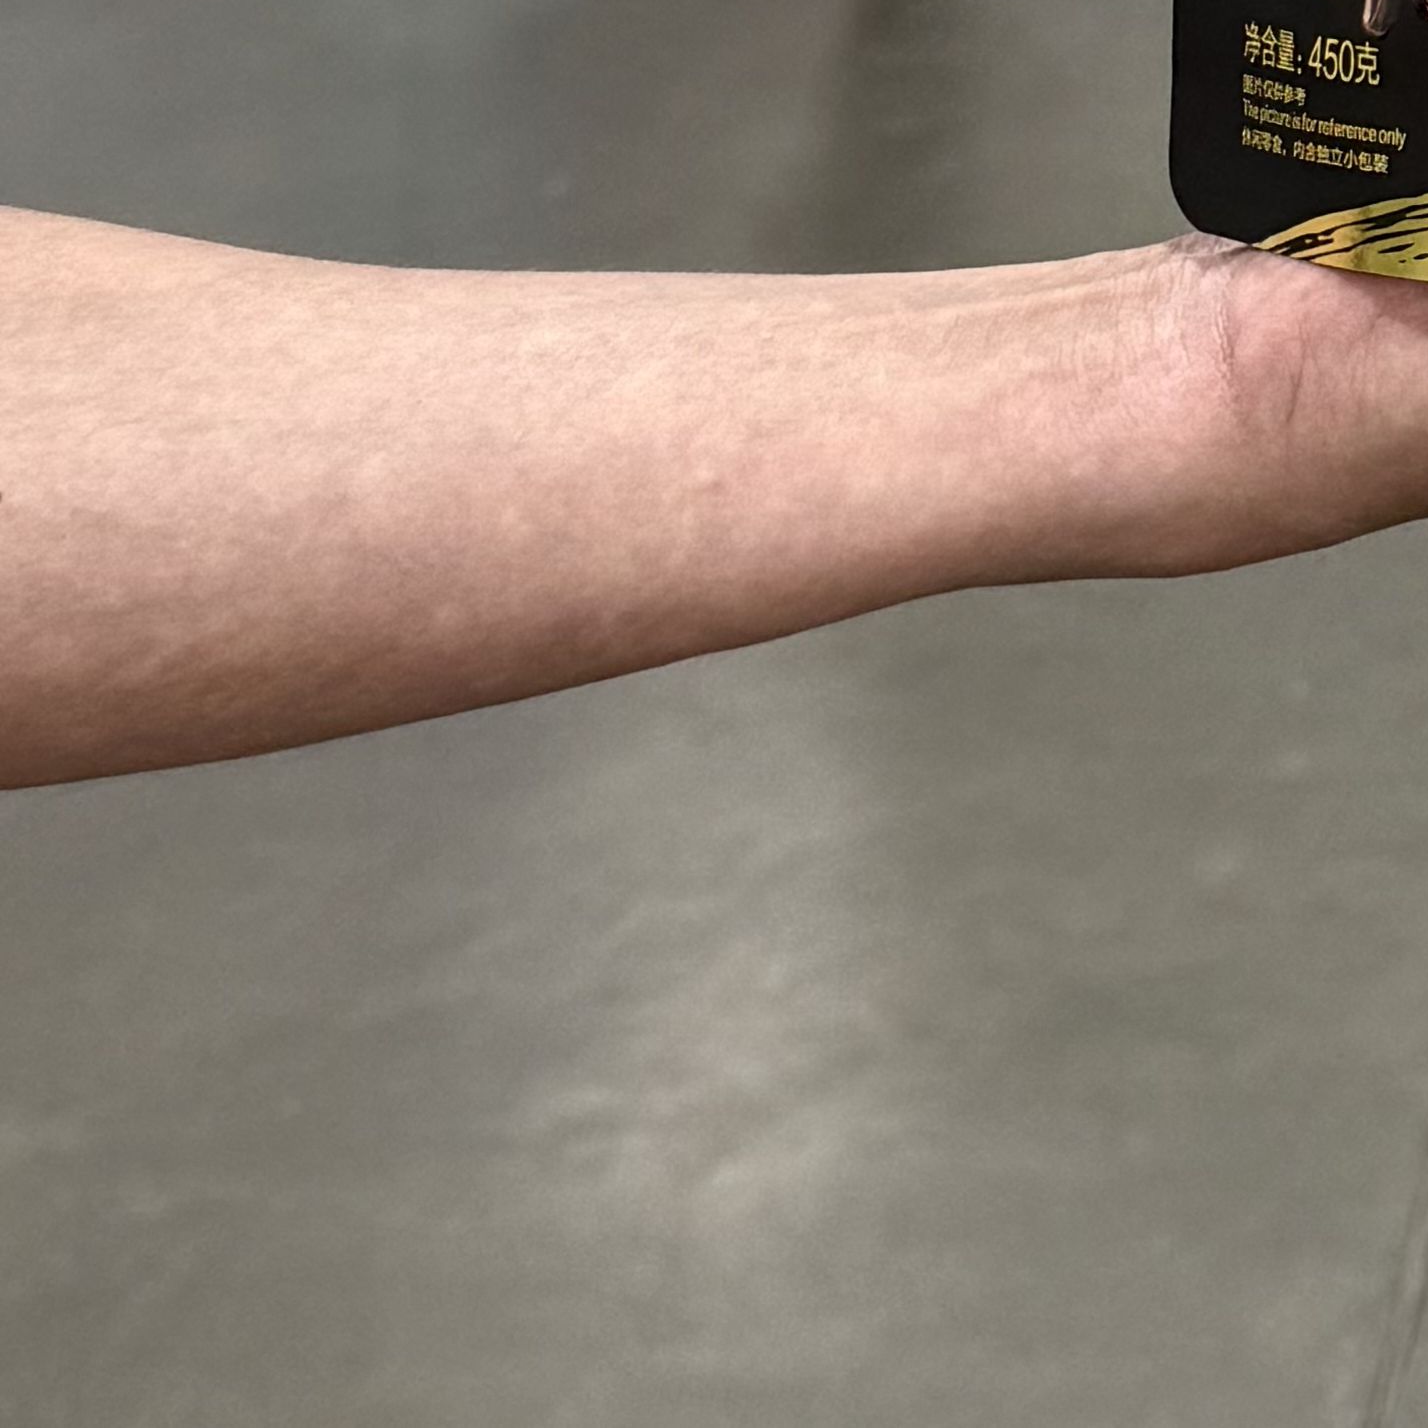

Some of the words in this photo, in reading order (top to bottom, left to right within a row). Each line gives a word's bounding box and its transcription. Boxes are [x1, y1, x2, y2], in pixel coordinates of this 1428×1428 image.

[1259, 104, 1292, 128] picture
[1301, 111, 1318, 133] for
[1318, 117, 1378, 143] reference
[1378, 127, 1407, 151] only
